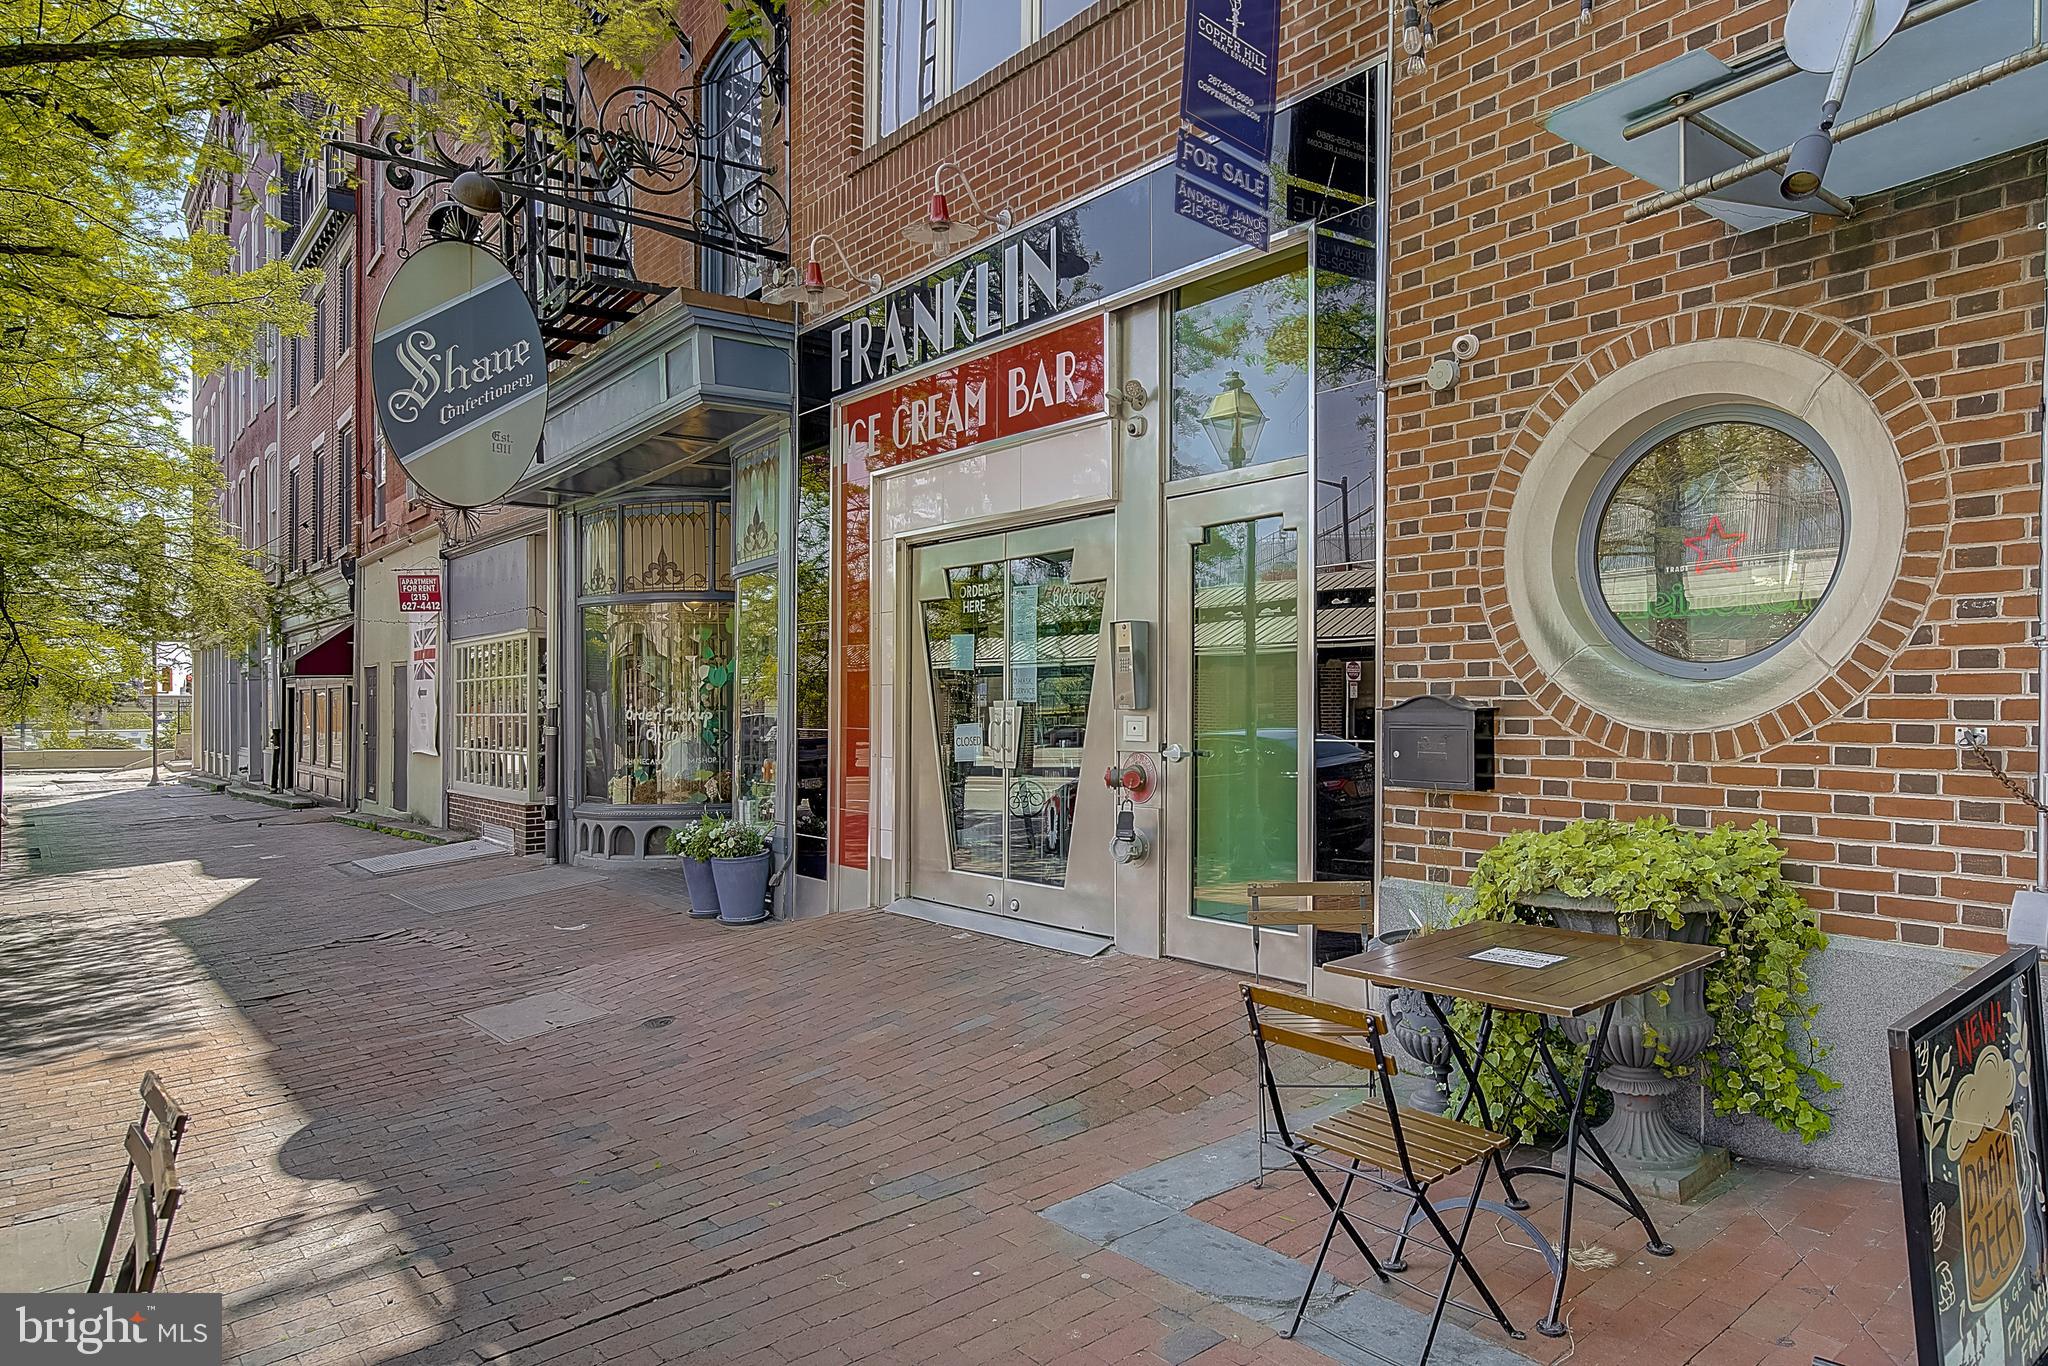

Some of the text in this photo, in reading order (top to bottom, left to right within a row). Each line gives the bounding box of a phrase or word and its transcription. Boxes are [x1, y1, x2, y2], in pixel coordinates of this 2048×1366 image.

[1198, 18, 1267, 70] COPPER HILL
[1212, 39, 1253, 69] REAL ESTATE
[1182, 141, 1266, 199] FOR SALE
[1178, 182, 1267, 233] ANDREW JANOS
[831, 226, 1058, 392] FRANKLIN
[387, 330, 530, 423] Shane
[439, 373, 534, 425] Confectionery
[842, 351, 1078, 463] ICE CREAM BAR
[491, 431, 514, 443] Est.
[491, 442, 511, 454] 1911
[401, 601, 441, 610] 627-4412
[410, 593, 429, 601] (215)
[418, 584, 435, 592] RENT
[960, 583, 989, 599] ORDER
[962, 599, 986, 613] HERE
[1053, 590, 1096, 607] PICKUPS
[955, 736, 982, 747] CLOSED
[1955, 1000, 2002, 1068] NEW!
[1965, 1133, 2011, 1223] DRAFT
[1970, 1187, 2021, 1289] BEER
[2012, 1267, 2027, 1303] GET
[2021, 1311, 2048, 1366] FRIE
